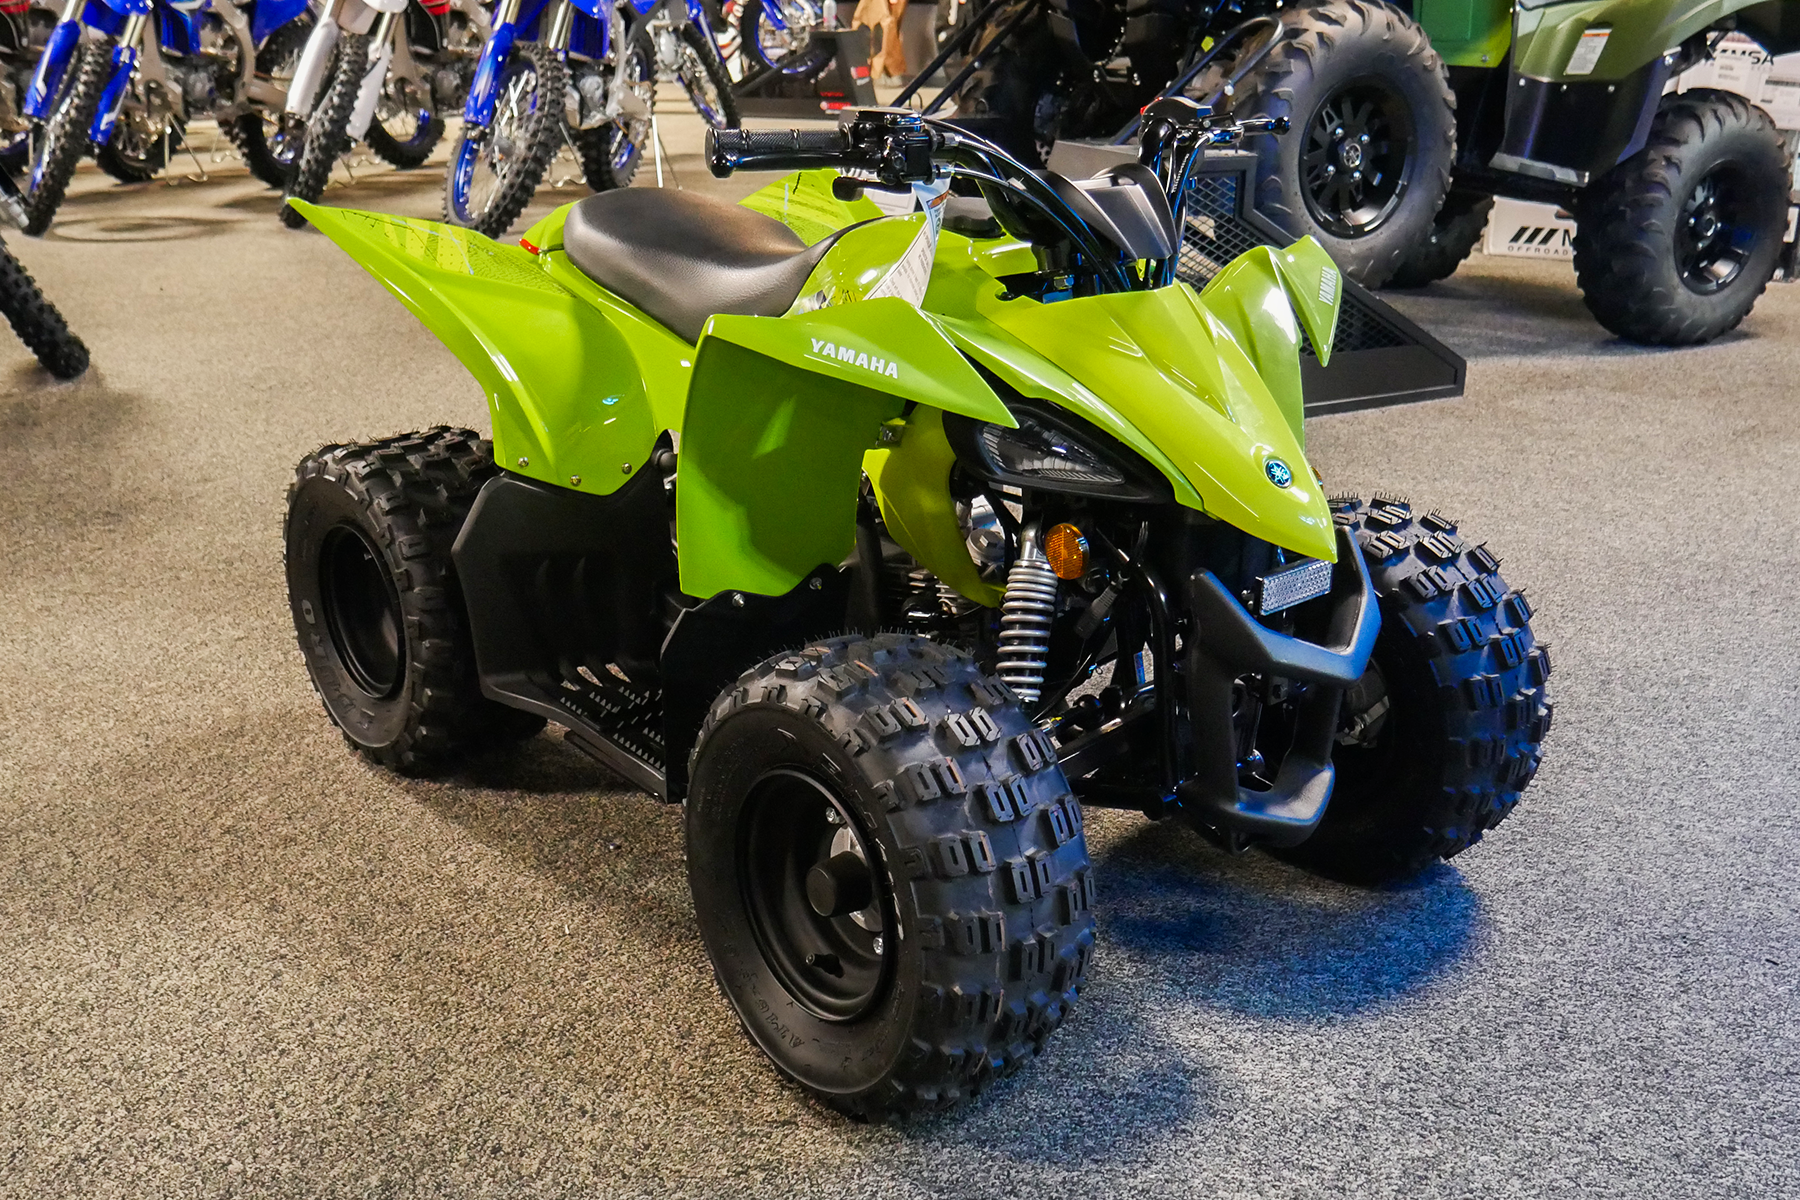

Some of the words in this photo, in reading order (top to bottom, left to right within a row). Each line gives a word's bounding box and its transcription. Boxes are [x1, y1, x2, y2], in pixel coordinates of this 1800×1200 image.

[1507, 245, 1568, 256] OFFROAD
[1318, 266, 1337, 306] YAMAHA
[810, 338, 898, 379] YAMAHA
